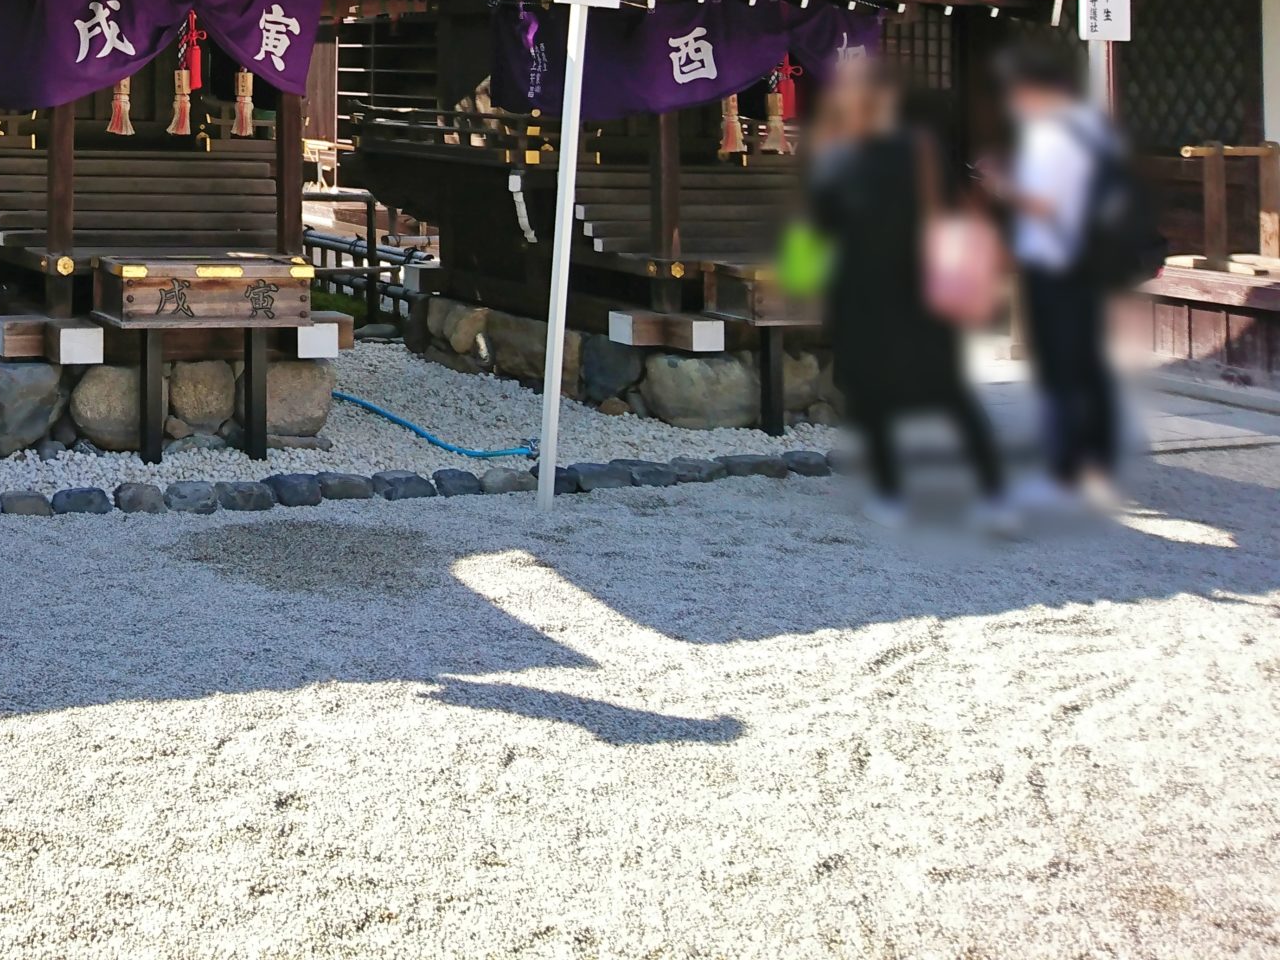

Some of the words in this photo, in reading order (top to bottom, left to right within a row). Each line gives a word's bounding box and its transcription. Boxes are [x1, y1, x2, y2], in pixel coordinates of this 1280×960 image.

[73, 0, 136, 64] 戌
[253, 3, 301, 72] 寅
[668, 26, 718, 85] 酉
[155, 277, 195, 319] 戌
[244, 278, 280, 320] 寅
